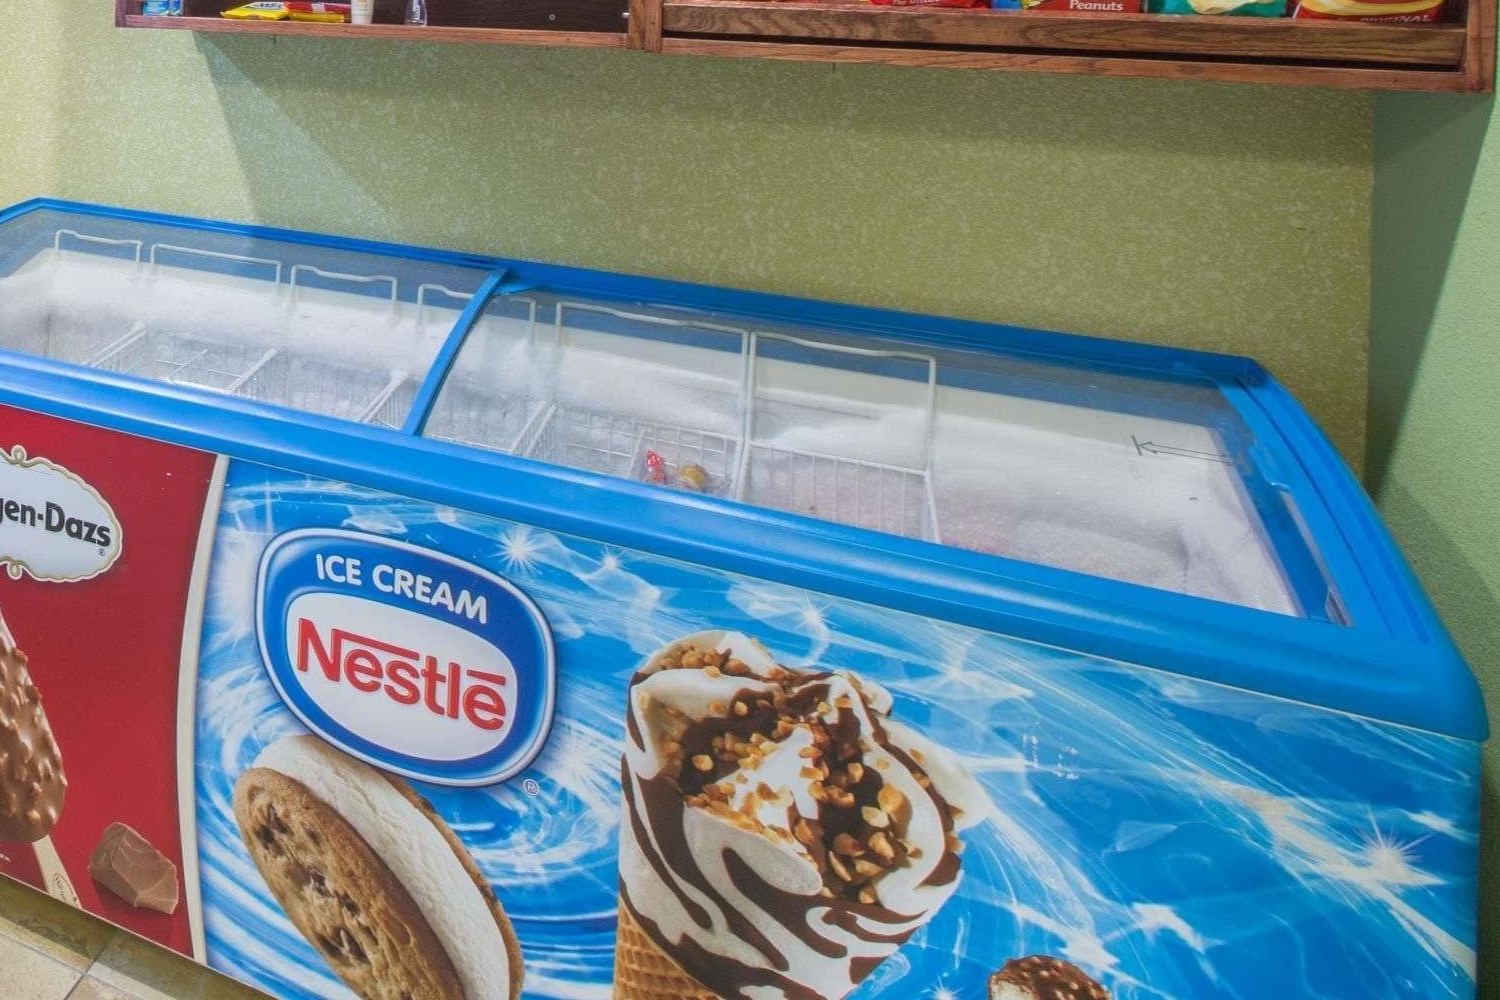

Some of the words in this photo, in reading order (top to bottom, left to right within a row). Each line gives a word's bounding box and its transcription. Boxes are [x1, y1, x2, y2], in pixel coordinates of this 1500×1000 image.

[1069, 0, 1124, 11] Peanuts
[315, 552, 362, 586] ICE
[372, 564, 487, 624] CREAM
